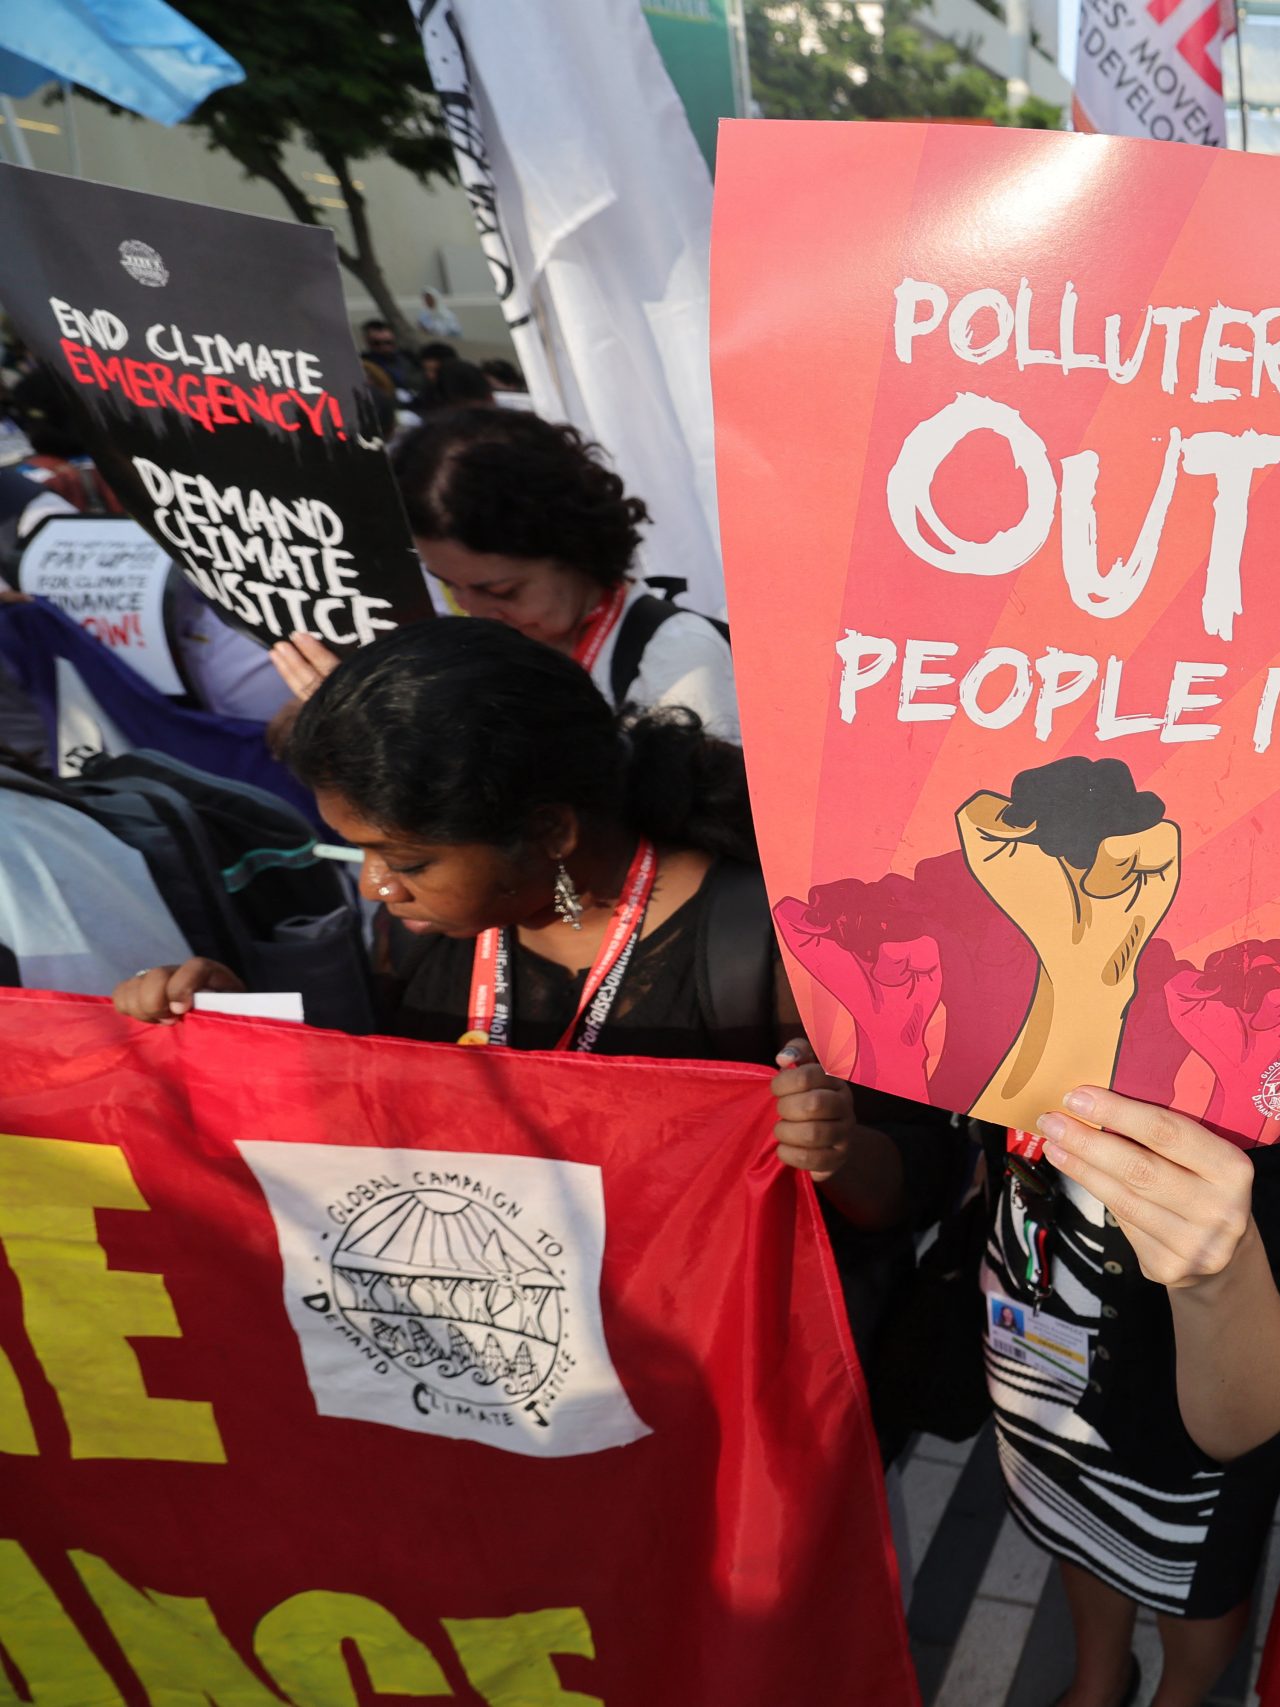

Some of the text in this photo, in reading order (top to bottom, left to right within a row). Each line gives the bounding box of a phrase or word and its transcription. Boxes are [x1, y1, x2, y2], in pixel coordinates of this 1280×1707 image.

[1084, 27, 1188, 144] DEVELO
[49, 297, 324, 395] END CLIMATE
[60, 337, 347, 441] EMERGENCY!
[132, 455, 344, 548] DEMAND
[154, 507, 360, 597] CLIMATE
[48, 592, 143, 612] INANCE
[80, 613, 146, 649] OW!
[835, 628, 1229, 744] PEOPLE
[1251, 1094, 1273, 1118] DEMAND
[327, 1172, 564, 1257] GLOBAL CAMPAIGN TO
[302, 1292, 390, 1375] DEMAND
[413, 1382, 514, 1427] CLIMATE
